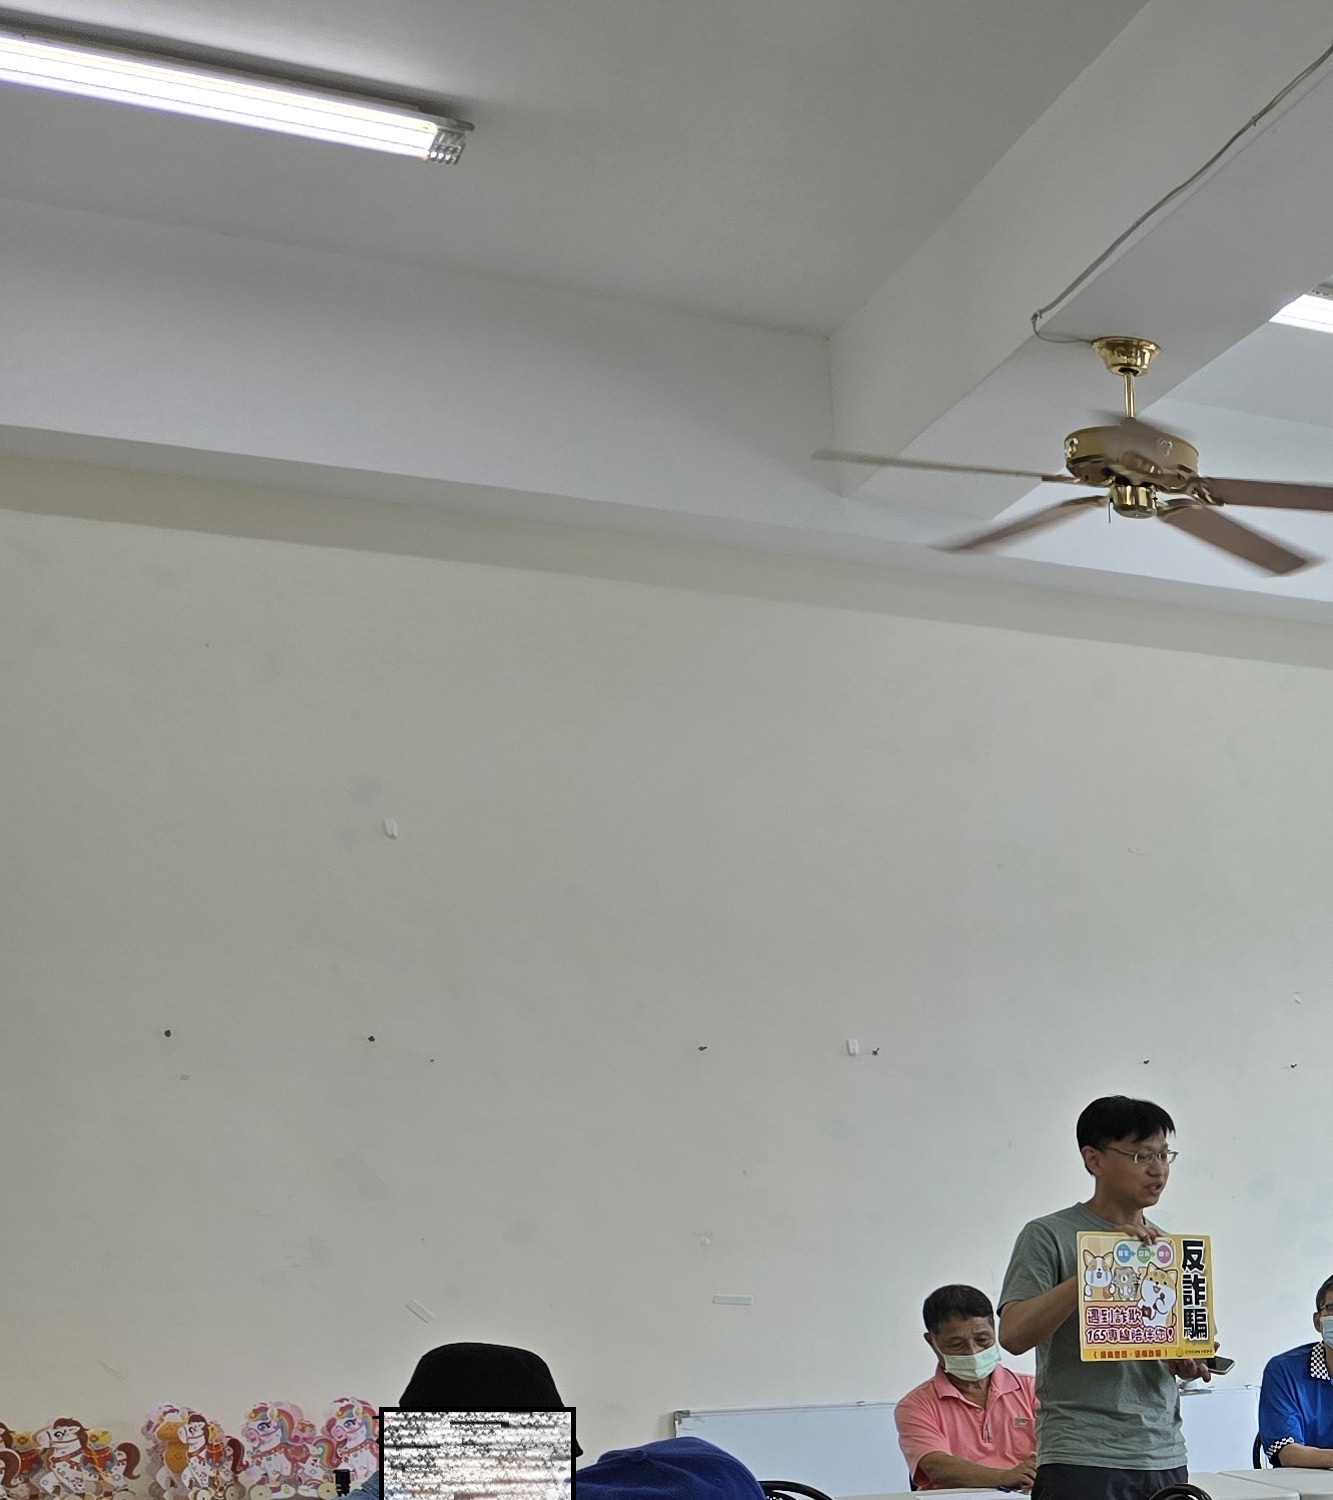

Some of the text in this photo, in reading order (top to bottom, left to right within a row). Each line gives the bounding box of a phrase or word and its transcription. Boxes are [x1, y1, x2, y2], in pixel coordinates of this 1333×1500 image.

[1087, 1307, 1142, 1325] 遇到詐欺
[1181, 1239, 1208, 1340] 反詐騙
